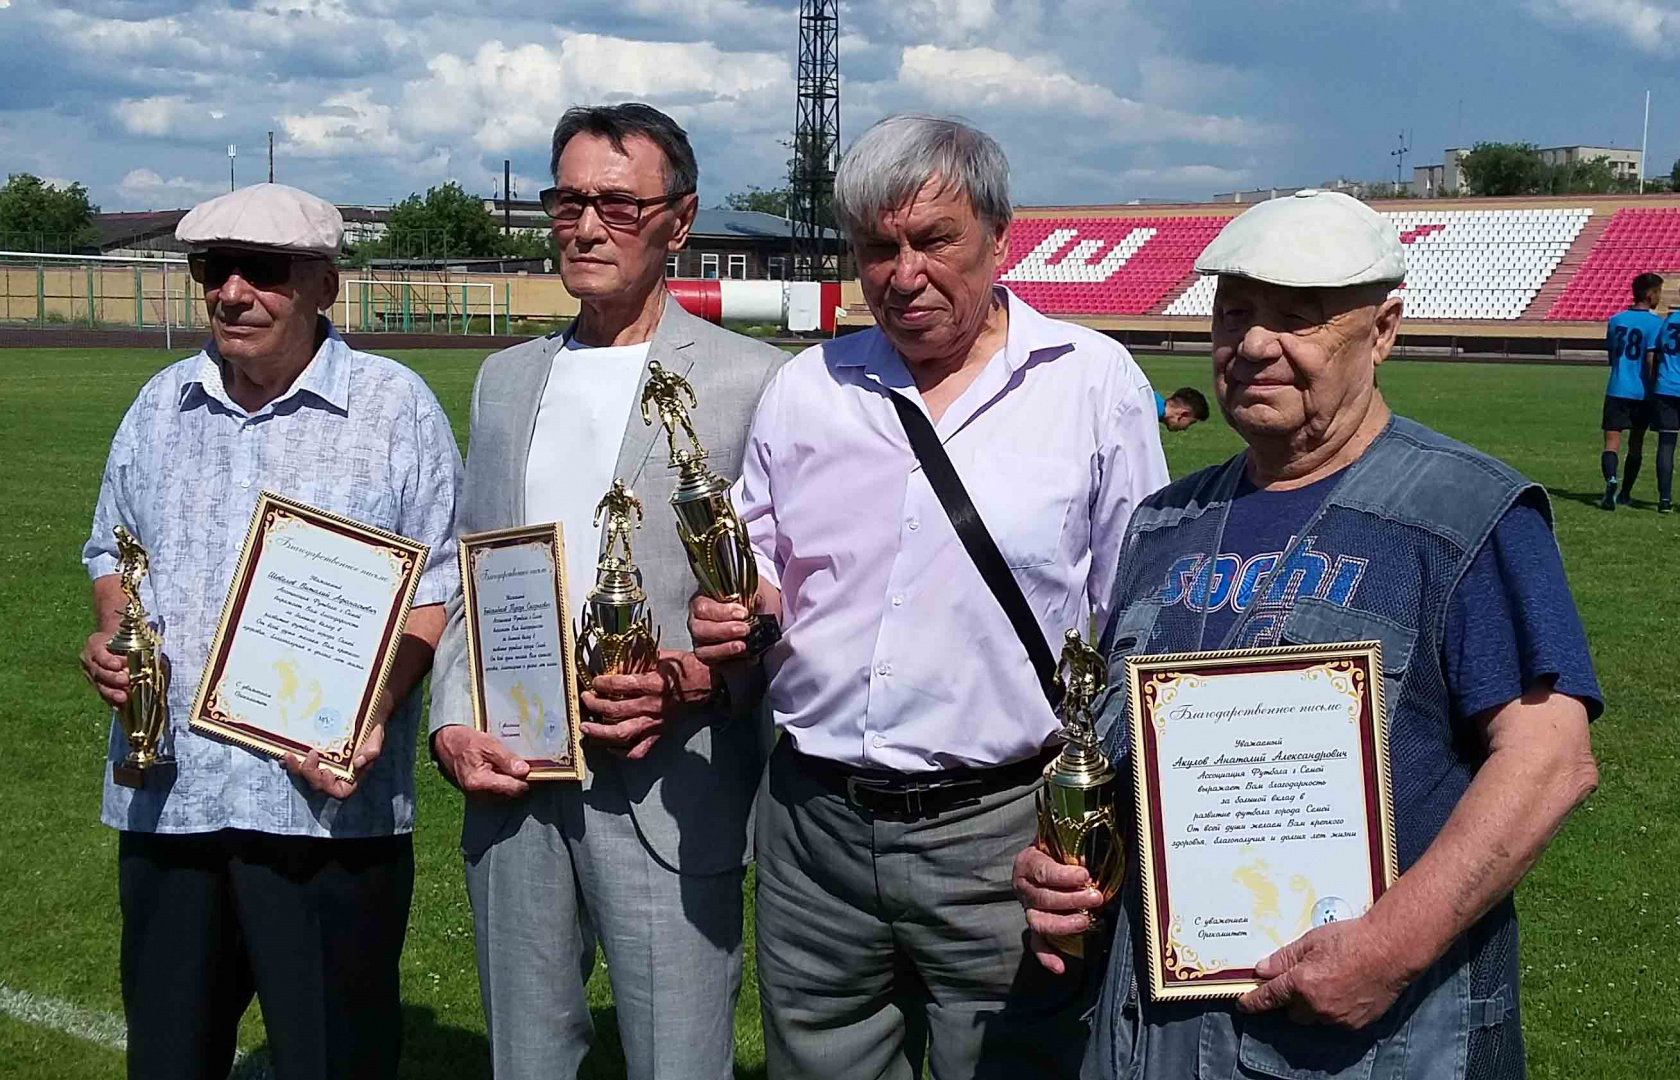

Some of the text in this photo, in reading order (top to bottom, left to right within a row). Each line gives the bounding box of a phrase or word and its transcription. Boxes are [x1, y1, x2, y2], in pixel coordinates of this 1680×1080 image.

[1169, 703, 1341, 723] Благодарственное письмо
[1172, 756, 1210, 768] Акулов
[1271, 749, 1347, 763] Александрович
[1197, 771, 1245, 780] Ассоциация
[1245, 782, 1263, 790] Вам
[1268, 780, 1326, 789] благодарность
[1234, 795, 1267, 804] большой
[1271, 794, 1295, 802] вклад
[1193, 811, 1231, 821] развитие
[1235, 808, 1270, 819] футбола
[1274, 808, 1300, 816] города
[1186, 824, 1199, 832] От
[1203, 823, 1221, 831] всей
[1225, 824, 1246, 833] души
[1287, 818, 1305, 827] Вам
[1310, 819, 1344, 827] крепкого
[1213, 836, 1265, 845] благополучия
[1280, 834, 1306, 843] долгих
[1204, 917, 1248, 927] уважением
[1198, 930, 1247, 939] Оргкомитет
